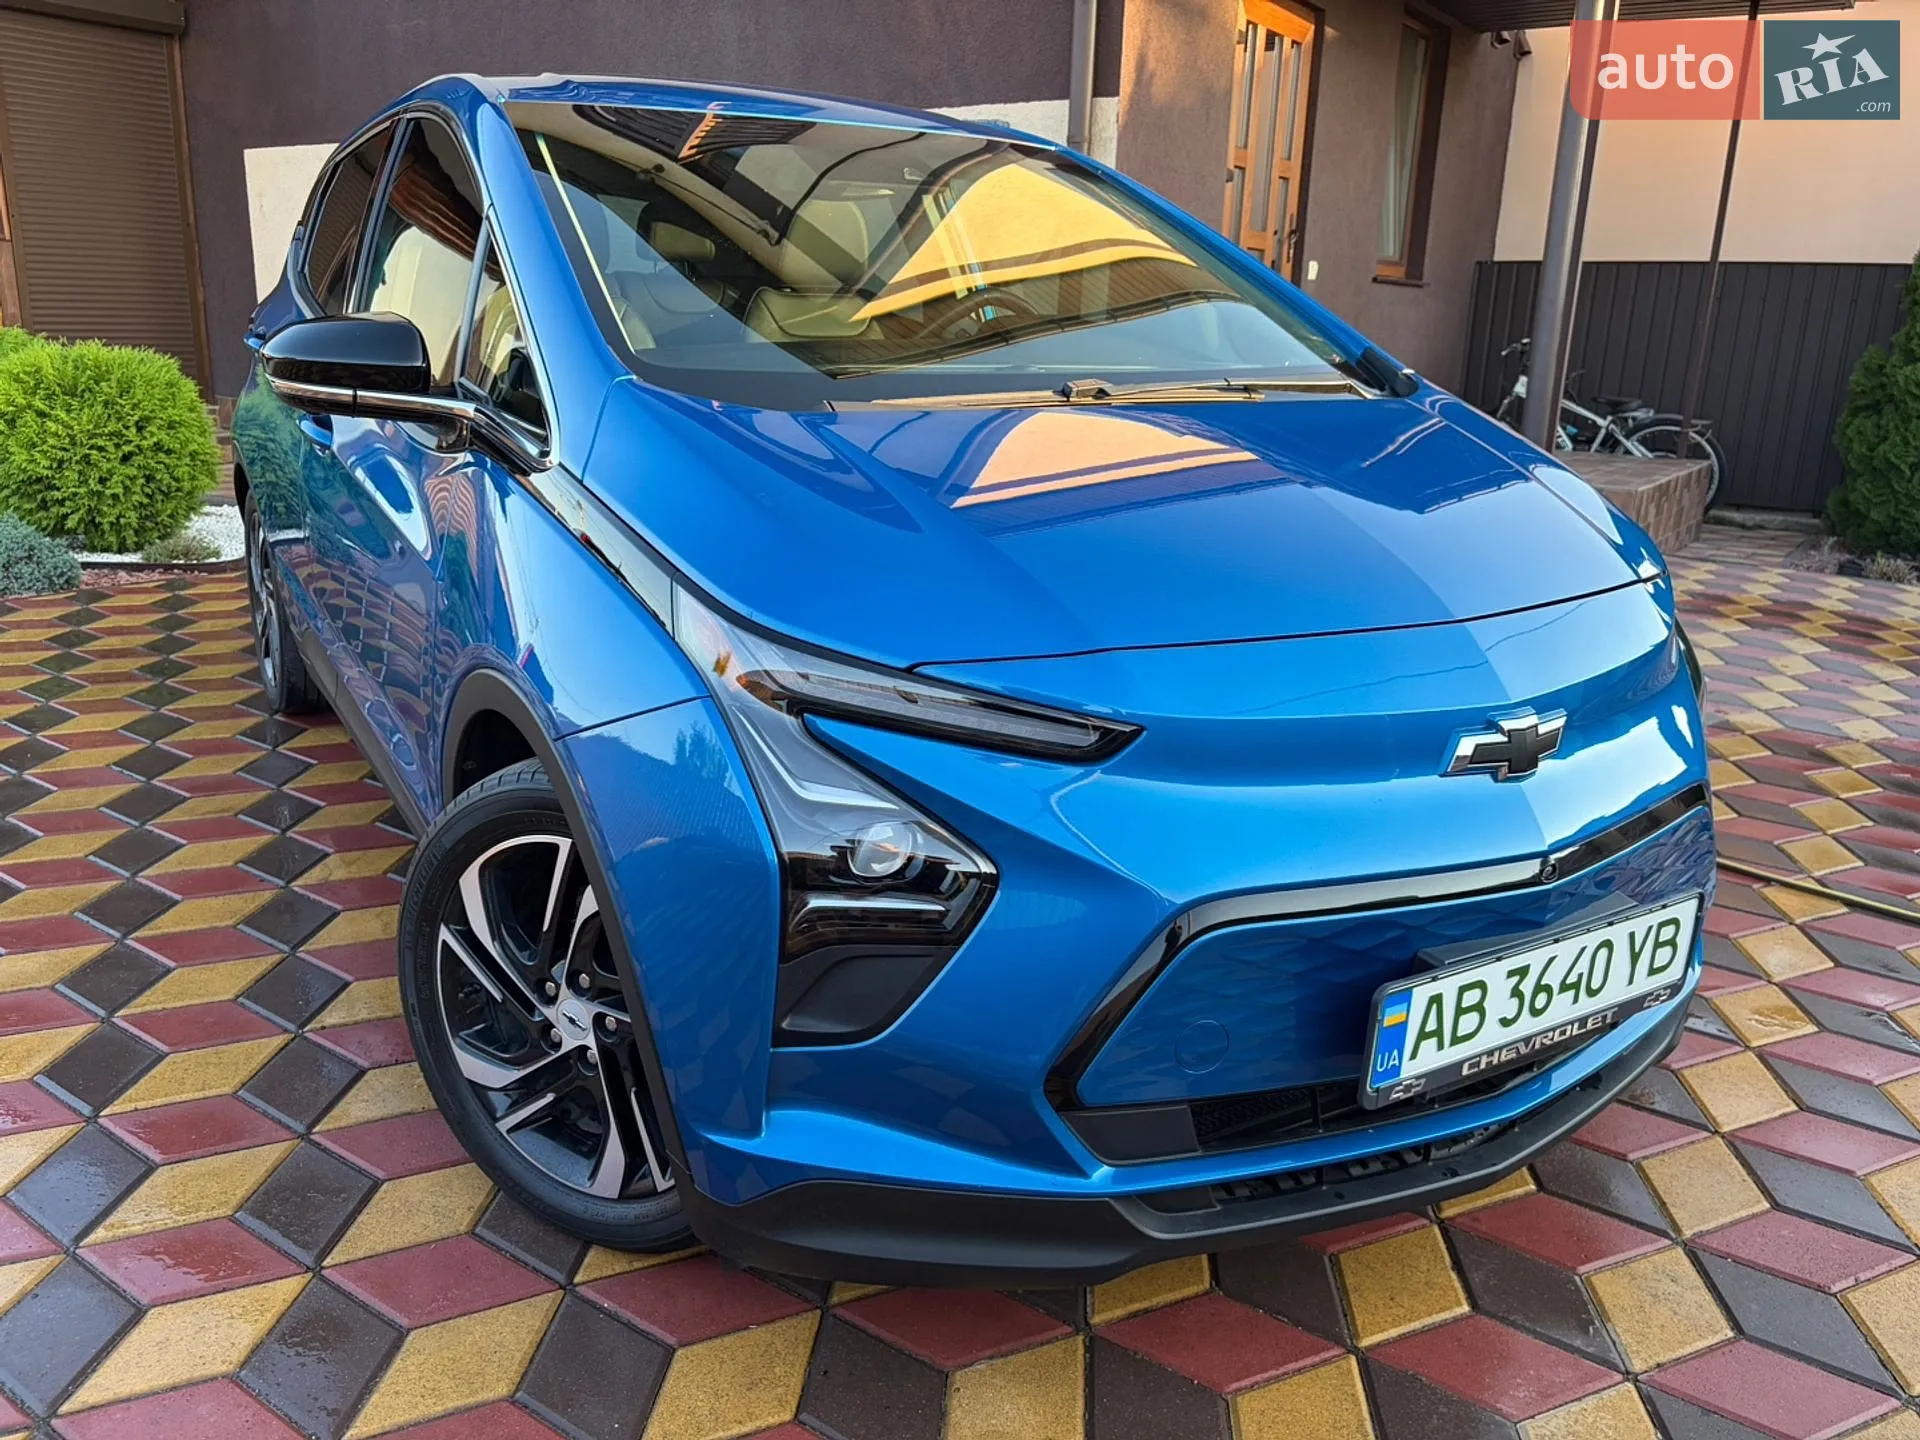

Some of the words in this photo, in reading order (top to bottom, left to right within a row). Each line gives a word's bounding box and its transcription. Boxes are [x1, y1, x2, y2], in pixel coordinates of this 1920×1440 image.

[1409, 979, 1489, 1061] AB
[1499, 938, 1615, 1029] 3640
[1628, 916, 1681, 987] YB
[1375, 1053, 1401, 1072] UA
[1461, 1008, 1619, 1076] CHEVROLET
